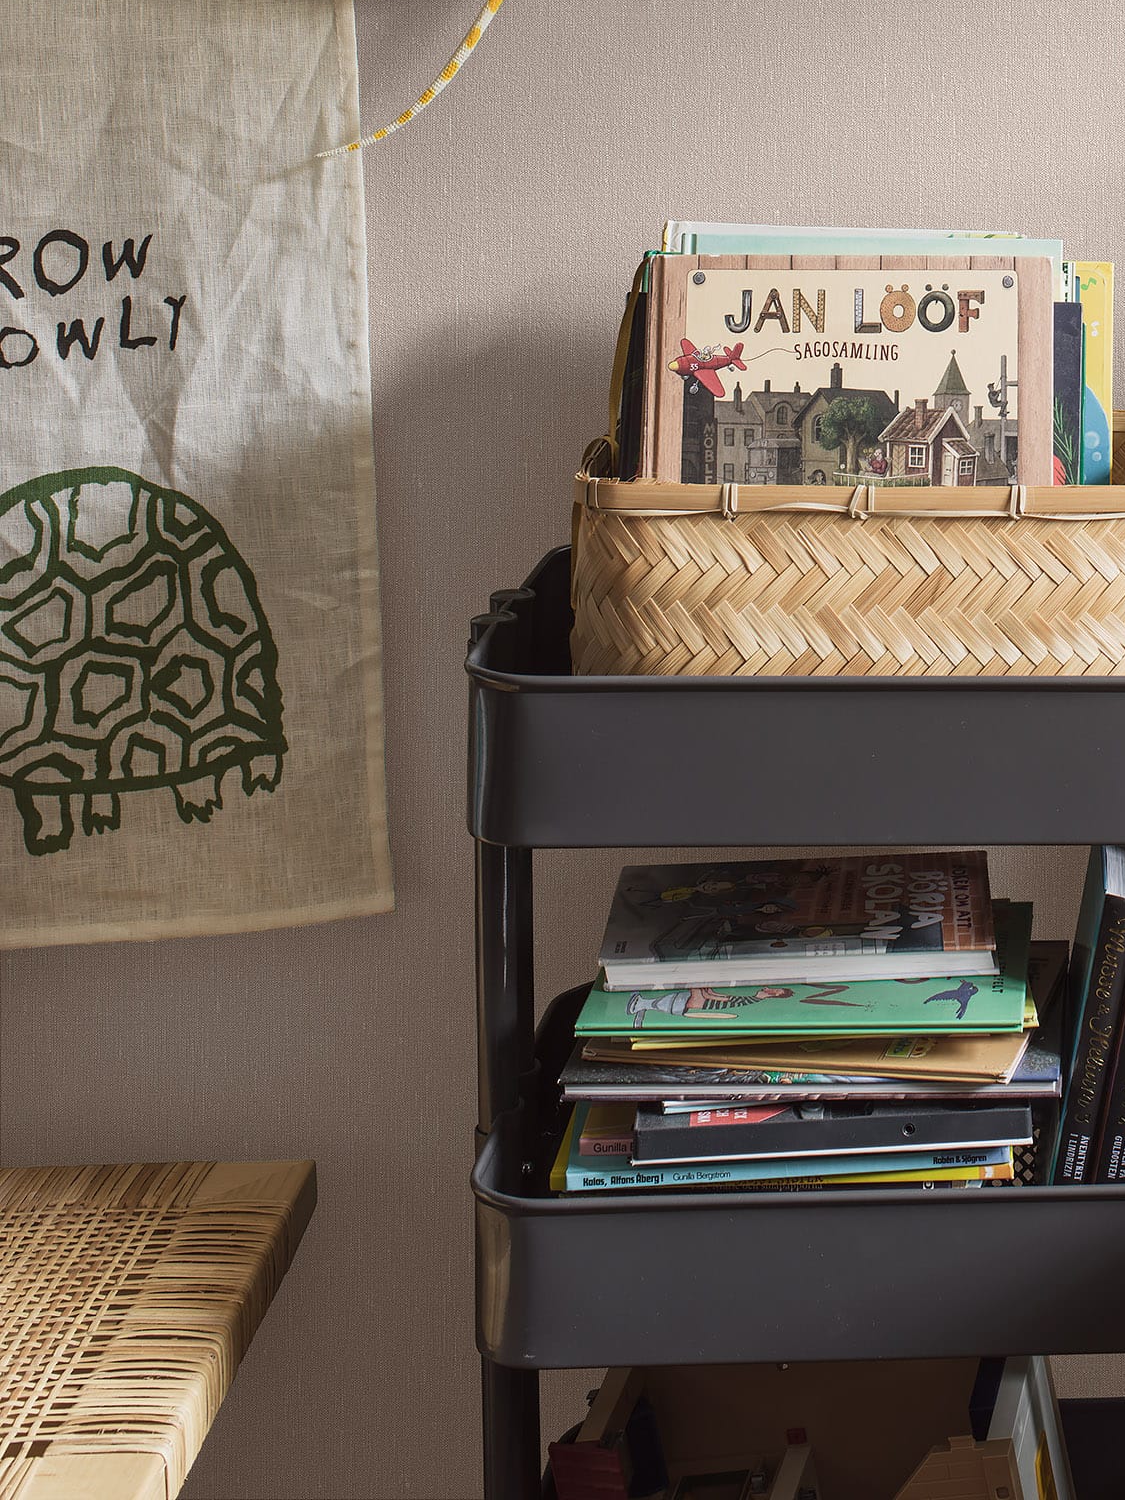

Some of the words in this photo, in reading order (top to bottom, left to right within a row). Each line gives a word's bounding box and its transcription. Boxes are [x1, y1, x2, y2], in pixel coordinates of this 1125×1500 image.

[724, 288, 826, 334] JAN
[854, 283, 986, 334] LÖÖF
[793, 341, 899, 361] SAGOSAMLING
[689, 363, 699, 371] 35
[859, 863, 904, 940] SKOLAN
[906, 870, 949, 930] BÖRJA
[955, 910, 972, 929] ATT
[593, 1142, 628, 1153] Gunilla
[610, 1175, 635, 1185] Alfons
